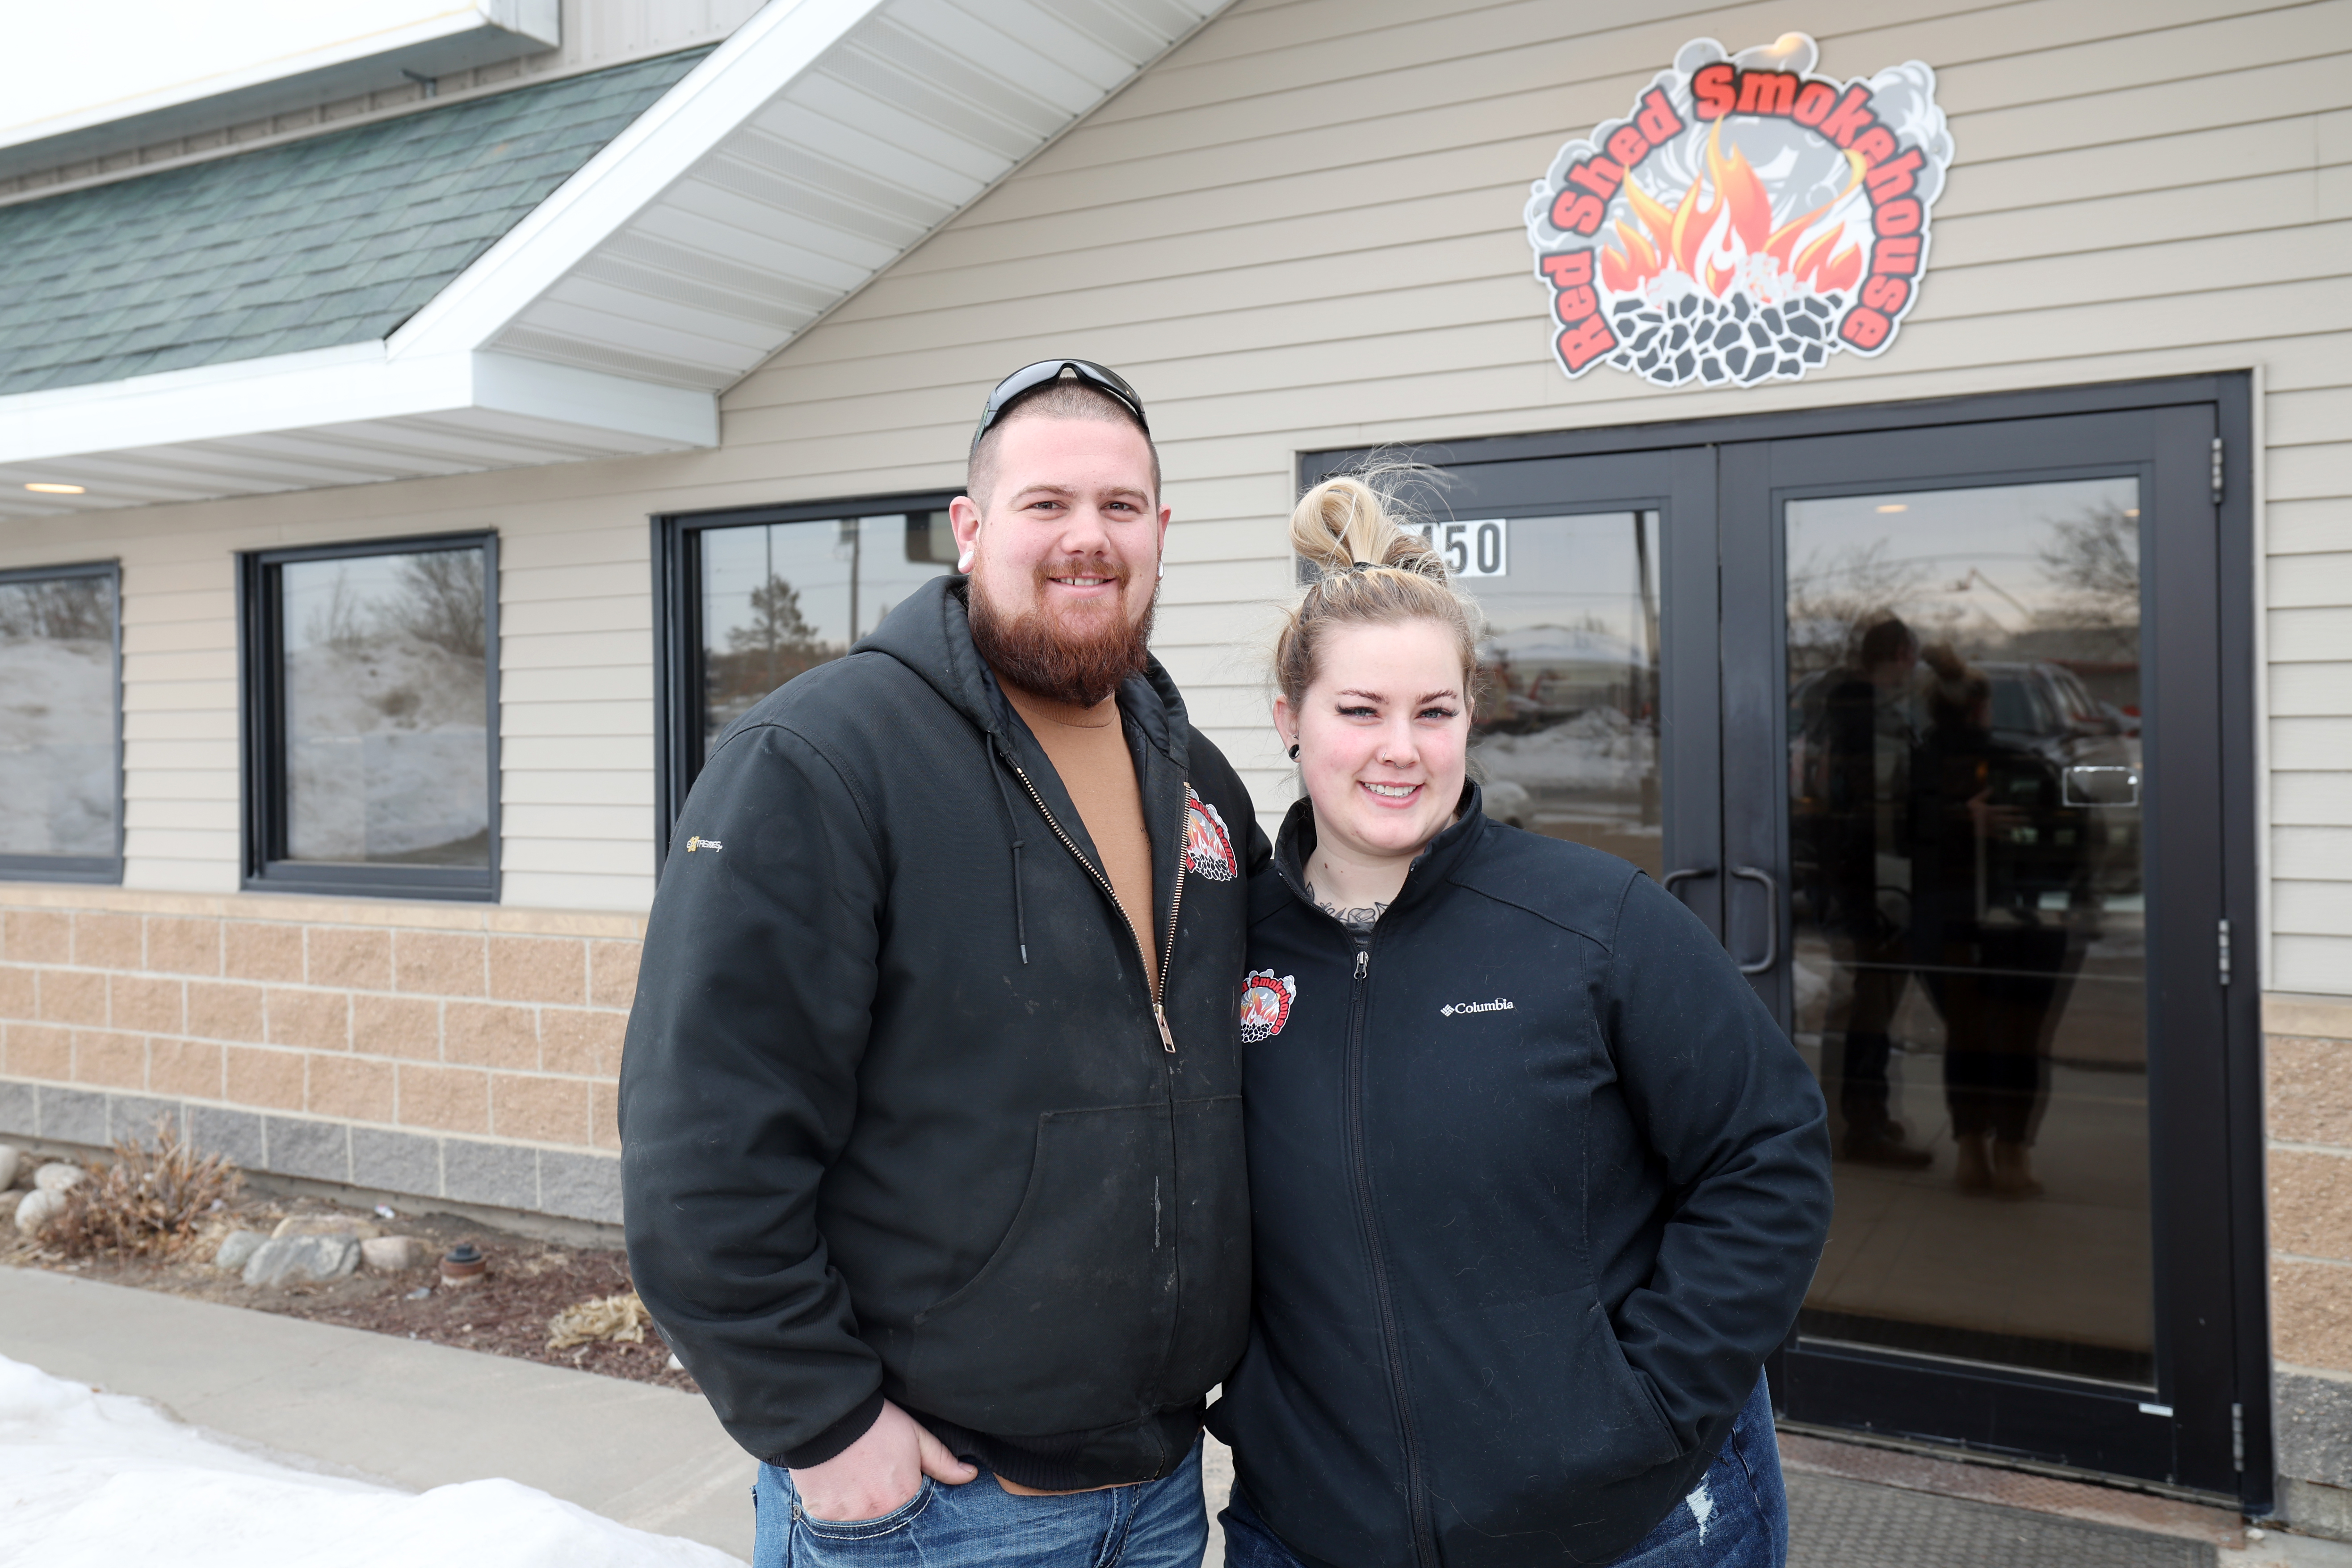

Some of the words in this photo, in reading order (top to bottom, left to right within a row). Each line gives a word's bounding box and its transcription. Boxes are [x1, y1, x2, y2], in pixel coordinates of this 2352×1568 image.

[1550, 86, 1684, 235] Shed
[1692, 63, 1924, 350] Smokehouse
[1541, 248, 1618, 371] Red
[1251, 975, 1291, 1034] Smokehouse
[1454, 999, 1514, 1014] Columbia
